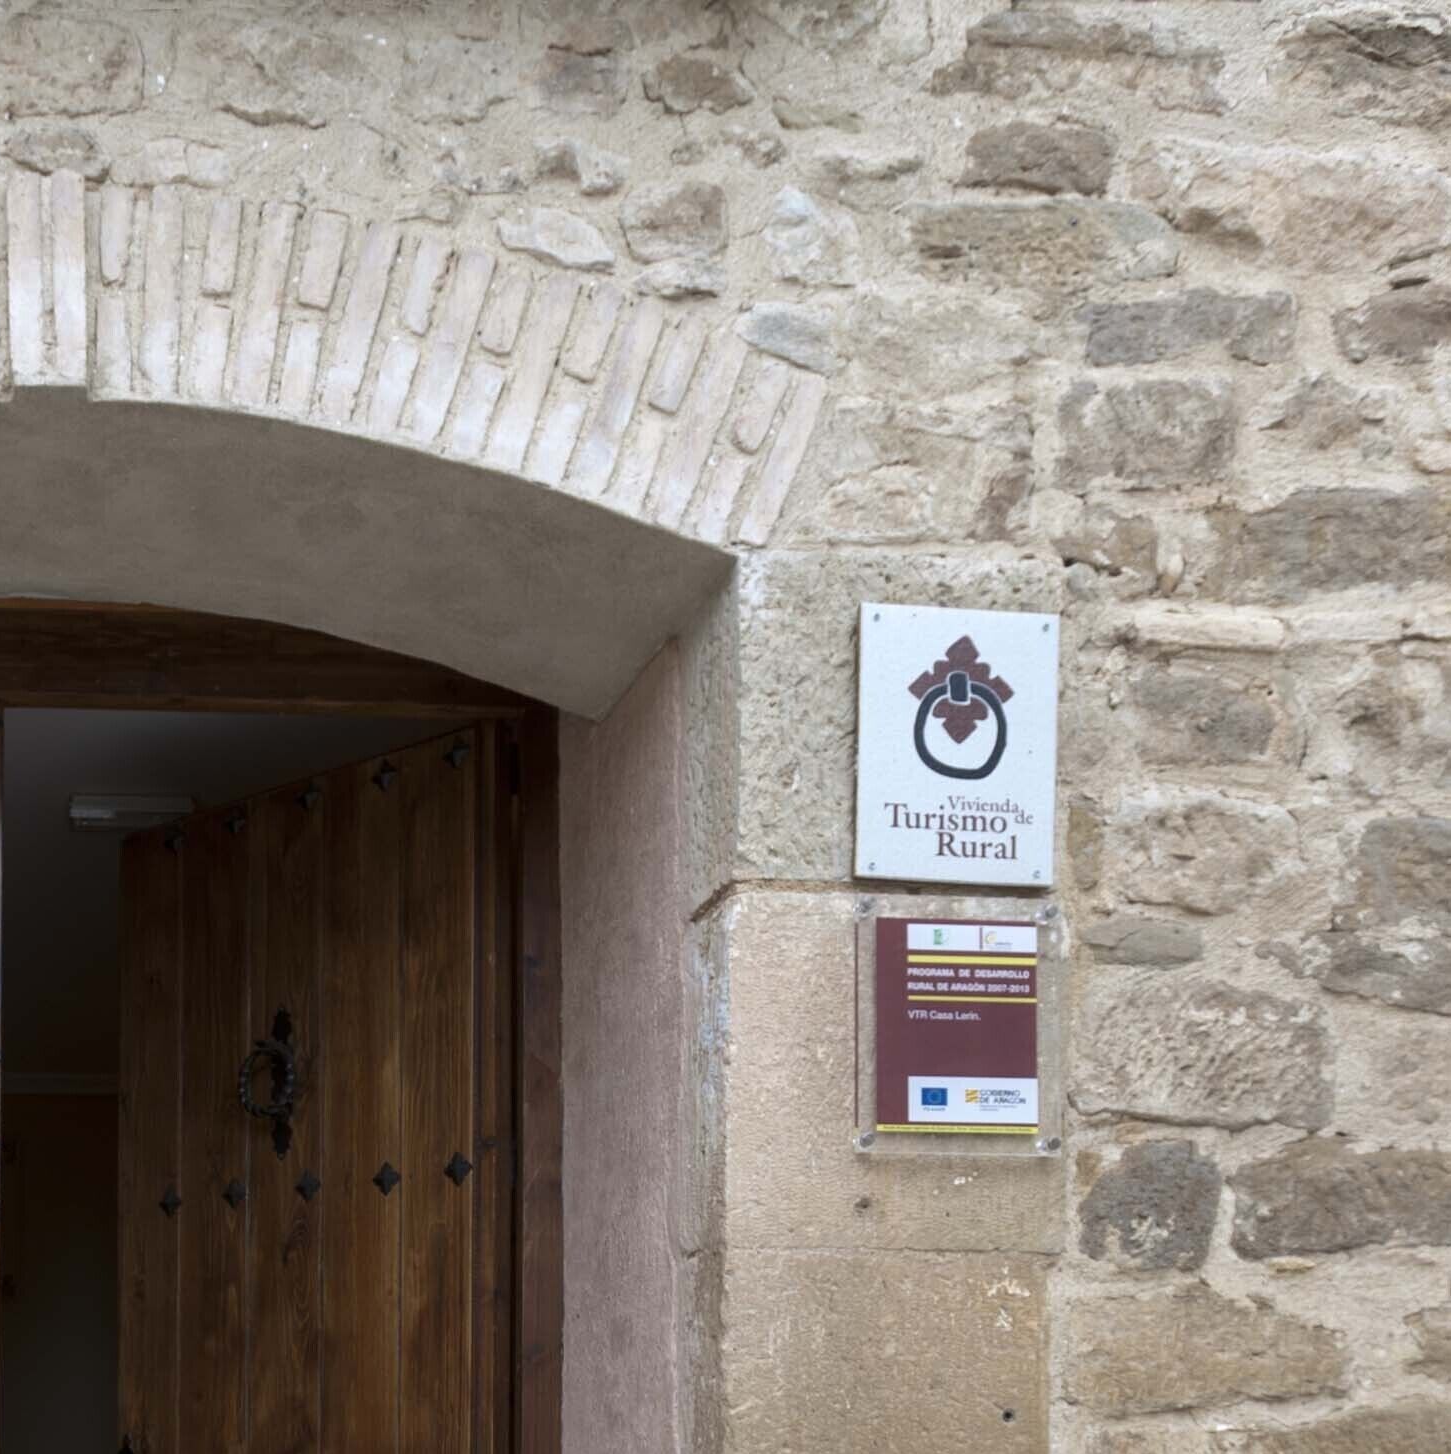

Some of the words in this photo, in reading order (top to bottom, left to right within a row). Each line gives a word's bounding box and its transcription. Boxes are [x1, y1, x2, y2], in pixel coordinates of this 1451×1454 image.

[947, 796, 1020, 814] Vivienda
[884, 803, 1008, 833] Turismo
[1014, 810, 1034, 825] de
[936, 832, 1017, 860] Rural
[907, 967, 955, 978] PROGRAMA
[959, 968, 971, 978] DE
[974, 969, 1030, 979] DESARROLLO
[907, 982, 935, 991] RURAL
[937, 982, 948, 991] DE
[907, 1010, 928, 1019] VTR
[929, 1010, 953, 1020] Casa
[980, 1089, 1020, 1097] GOBIERNO
[980, 1096, 990, 1104] DE
